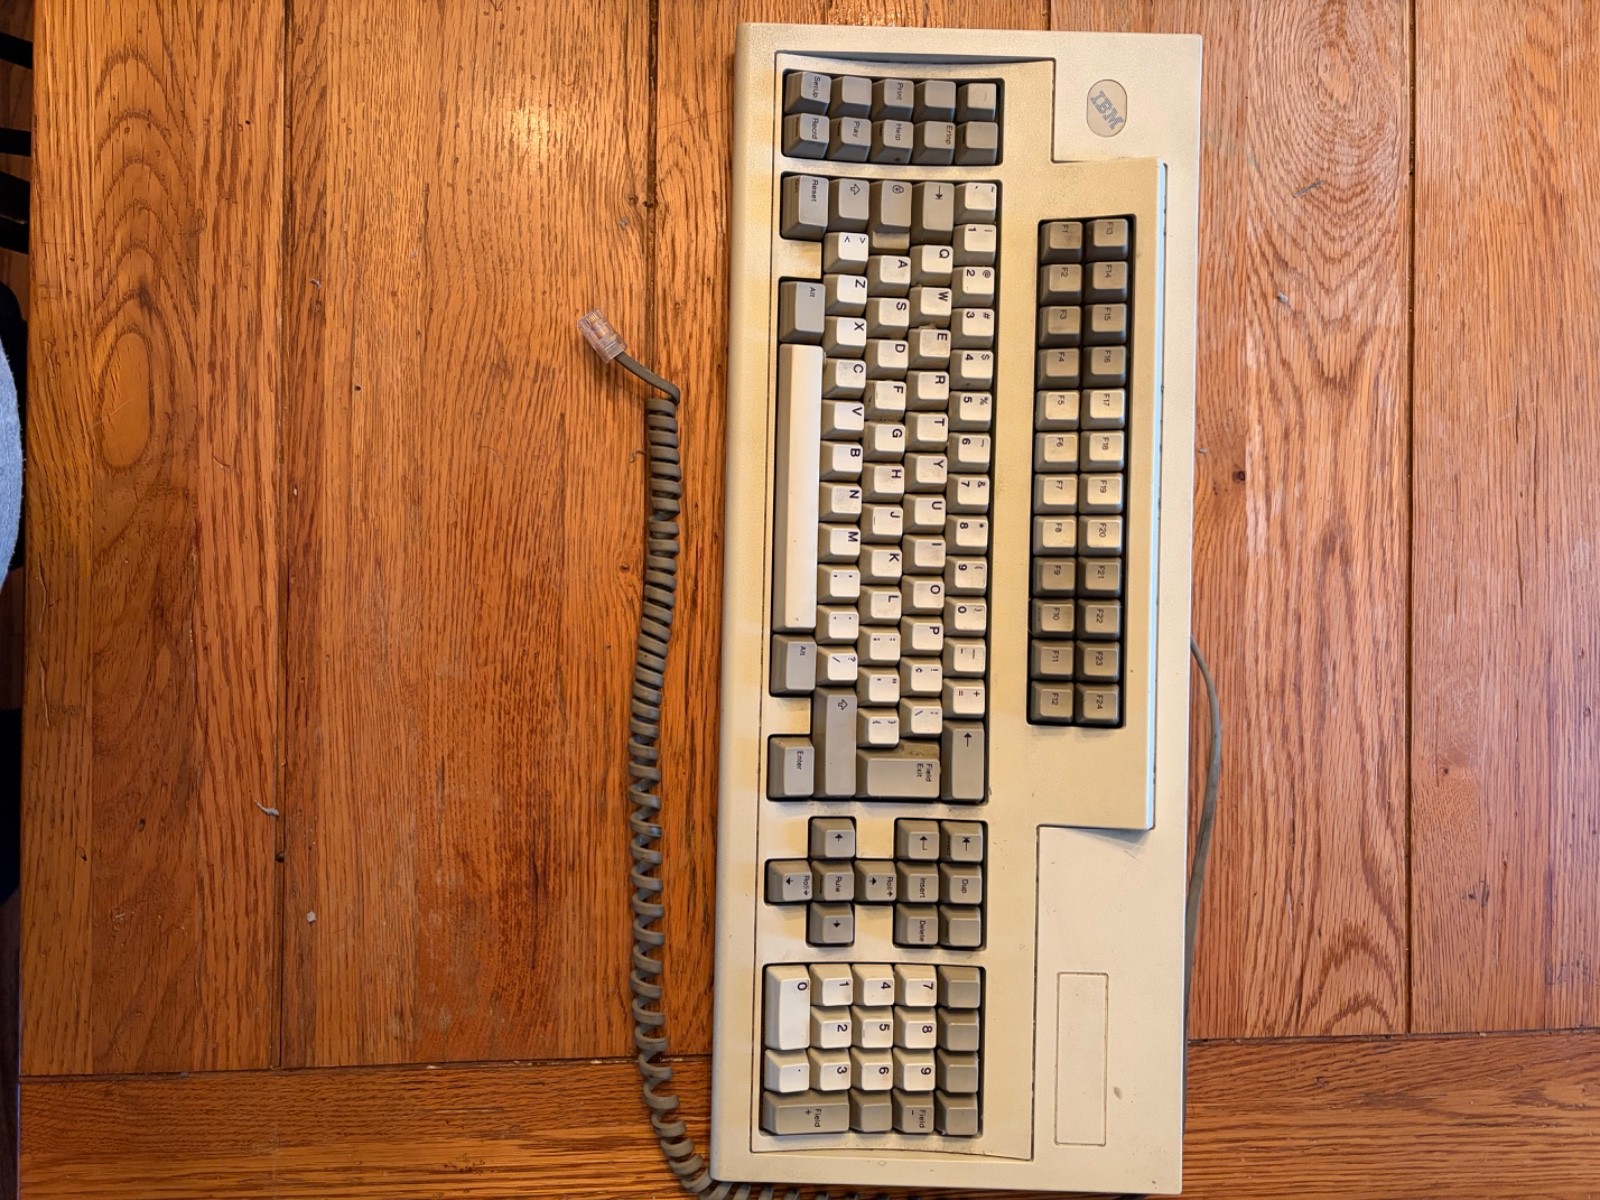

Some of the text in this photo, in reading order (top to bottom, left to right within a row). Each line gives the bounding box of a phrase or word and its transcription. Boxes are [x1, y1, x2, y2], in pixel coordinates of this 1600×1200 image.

[1090, 90, 1124, 130] IBM
[811, 118, 820, 140] Recrd
[852, 120, 860, 138] Play
[810, 180, 818, 202] Reset
[1062, 224, 1068, 233] F1
[1106, 222, 1114, 235] F13
[938, 248, 950, 260] Q
[898, 259, 908, 269] A
[966, 268, 976, 277] 2
[982, 270, 992, 279] @
[1060, 266, 1068, 278] F2
[854, 278, 866, 288] Z
[938, 291, 949, 302] W
[896, 302, 907, 311] S
[966, 311, 976, 319] 3
[982, 312, 991, 320] #
[1059, 309, 1067, 320] F3
[854, 322, 865, 332] X
[936, 332, 948, 341] E
[894, 344, 906, 354] D
[1058, 351, 1066, 363] F4
[853, 364, 864, 374] C
[934, 375, 946, 385] R
[893, 385, 904, 394] F
[963, 396, 973, 404] 5
[979, 397, 989, 405] %
[1057, 394, 1066, 406] F5
[852, 406, 863, 416] V
[934, 418, 945, 427] T
[892, 428, 903, 438] G
[961, 438, 971, 446] 6
[1056, 436, 1064, 448] F6
[1102, 436, 1110, 450] F18
[850, 448, 861, 458] B
[932, 460, 945, 469] Y
[890, 469, 902, 479] H
[976, 480, 986, 488] &
[1056, 480, 1063, 490] F7
[1100, 480, 1108, 494] F19
[850, 489, 860, 499] N
[931, 501, 942, 511] U
[890, 510, 900, 518] J
[959, 522, 969, 530] 8
[1054, 522, 1062, 534] F8
[1098, 522, 1106, 538] F20
[848, 532, 859, 542] M
[888, 553, 900, 562] K
[958, 564, 968, 572] 9
[1054, 564, 1062, 576] F9
[930, 584, 941, 595] O
[957, 606, 967, 614] 0
[1052, 607, 1060, 621] F10
[1096, 608, 1104, 624] F22
[928, 626, 940, 636] P
[1095, 651, 1103, 666] F23
[796, 750, 804, 771] Enter
[925, 763, 933, 783] Field
[960, 878, 968, 894] Dup
[918, 920, 926, 942] Delete
[796, 982, 808, 991] 0
[880, 982, 892, 990] 4
[837, 1024, 848, 1032] 2
[878, 1024, 890, 1032] 5
[922, 1024, 933, 1034] 8
[836, 1066, 848, 1075] 3
[878, 1066, 890, 1075] 6
[920, 1067, 932, 1076] 9
